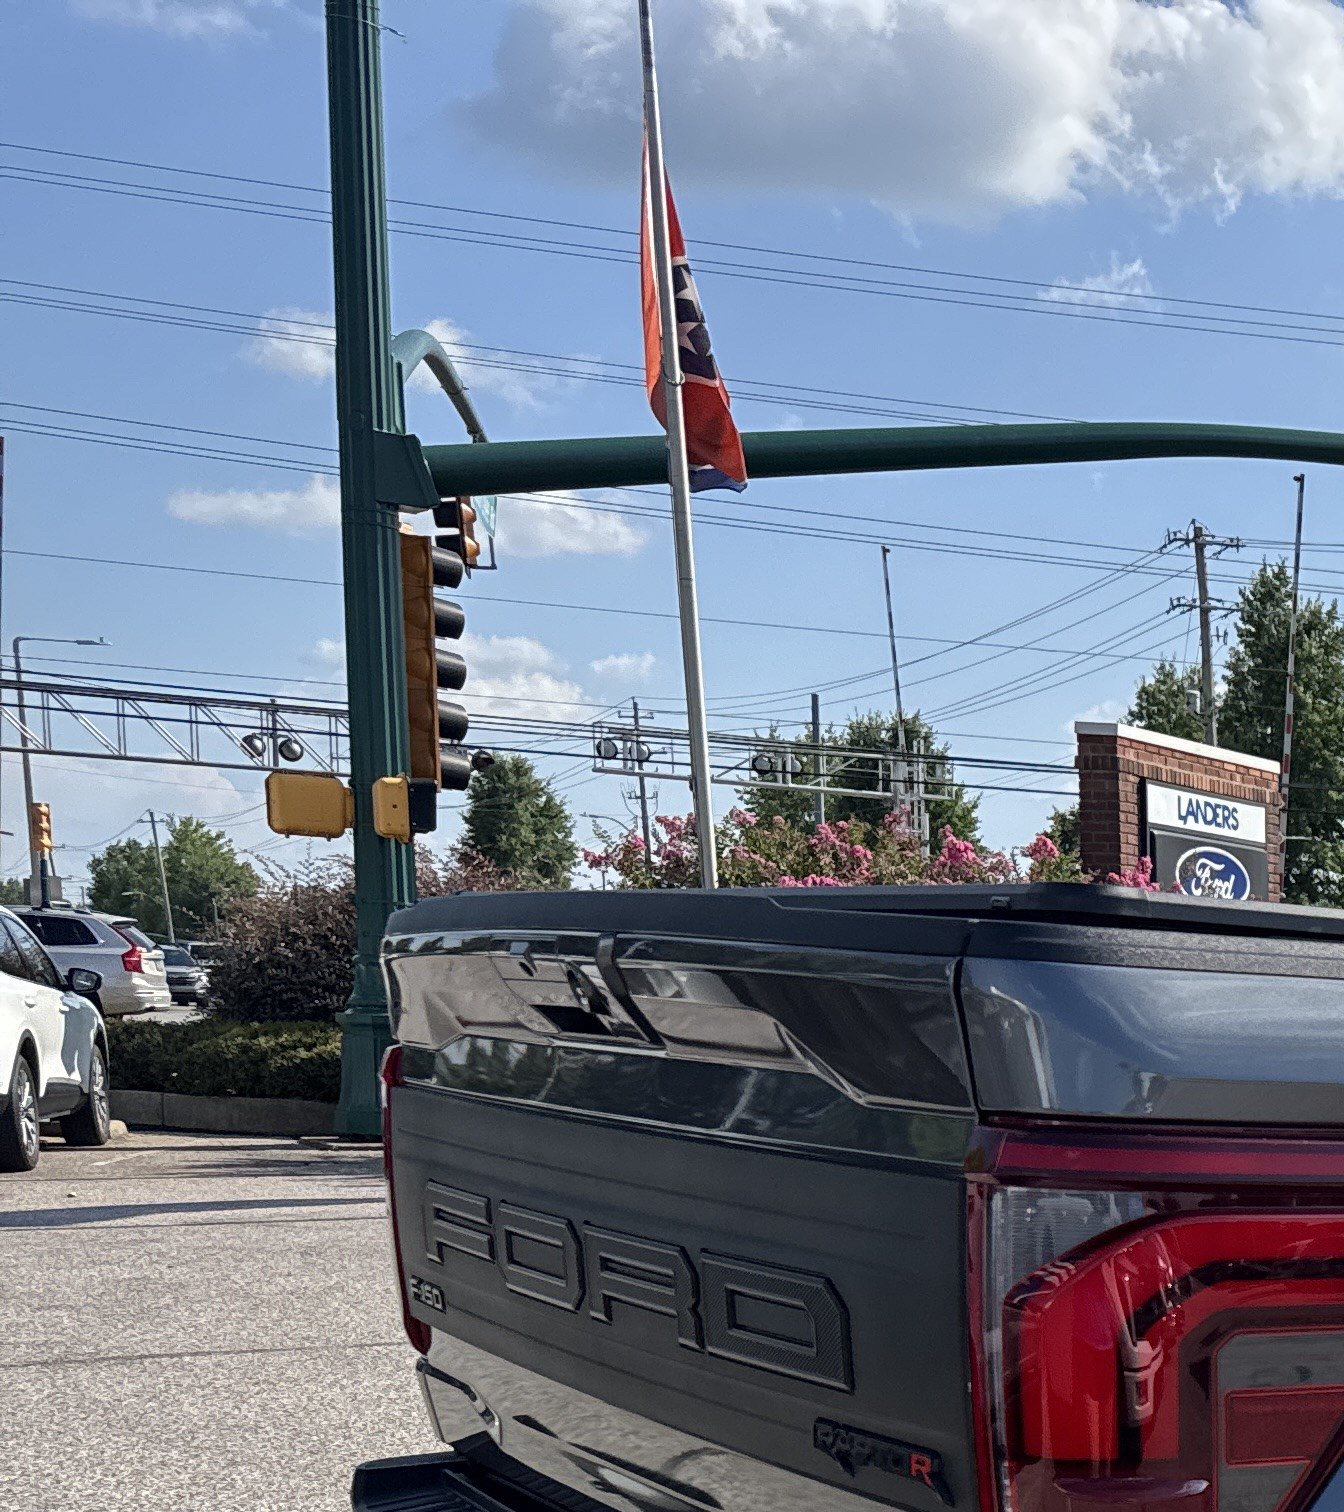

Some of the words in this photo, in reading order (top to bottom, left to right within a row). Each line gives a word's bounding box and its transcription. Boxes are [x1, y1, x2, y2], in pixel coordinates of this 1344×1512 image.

[1177, 794, 1239, 832] LANDERS
[1191, 857, 1236, 900] Ford
[424, 1179, 856, 1395] FORD
